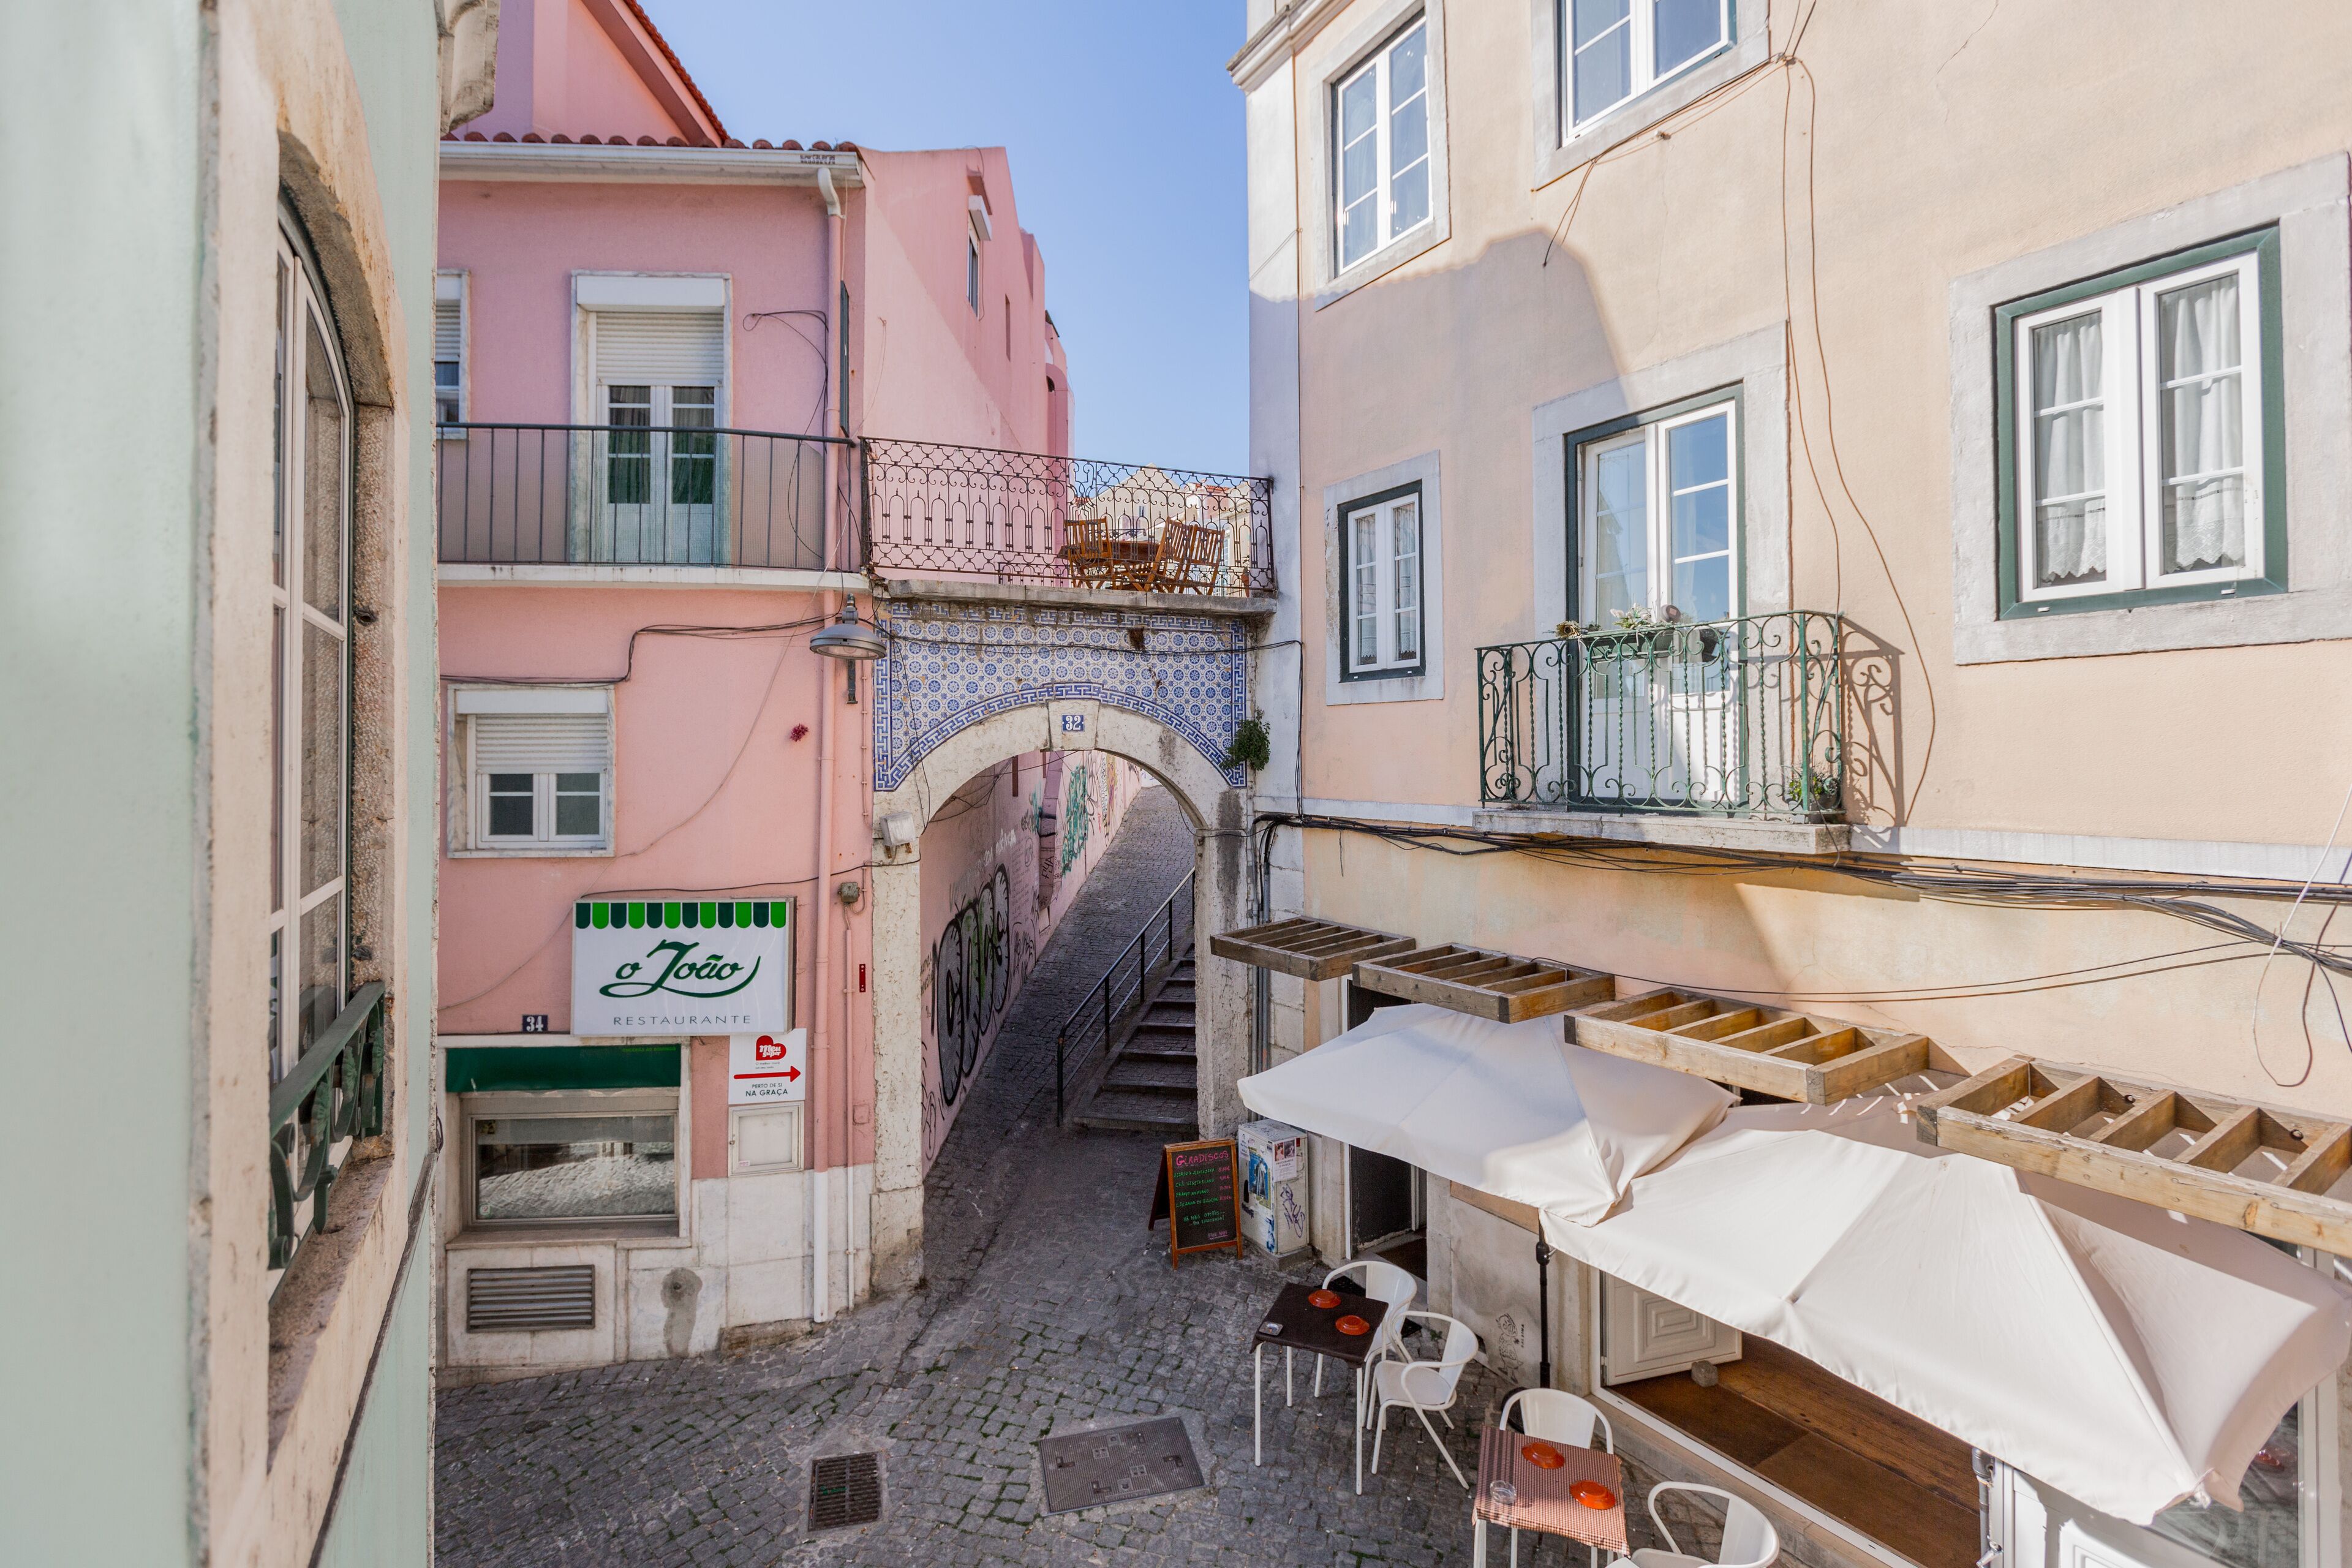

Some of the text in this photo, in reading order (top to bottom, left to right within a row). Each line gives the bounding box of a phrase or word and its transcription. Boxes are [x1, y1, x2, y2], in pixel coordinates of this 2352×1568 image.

[1066, 715, 1081, 731] 32
[616, 962, 643, 980] o
[526, 1016, 544, 1032] 34
[613, 1015, 751, 1026] RESTAURANTE
[759, 1044, 781, 1053] Meu
